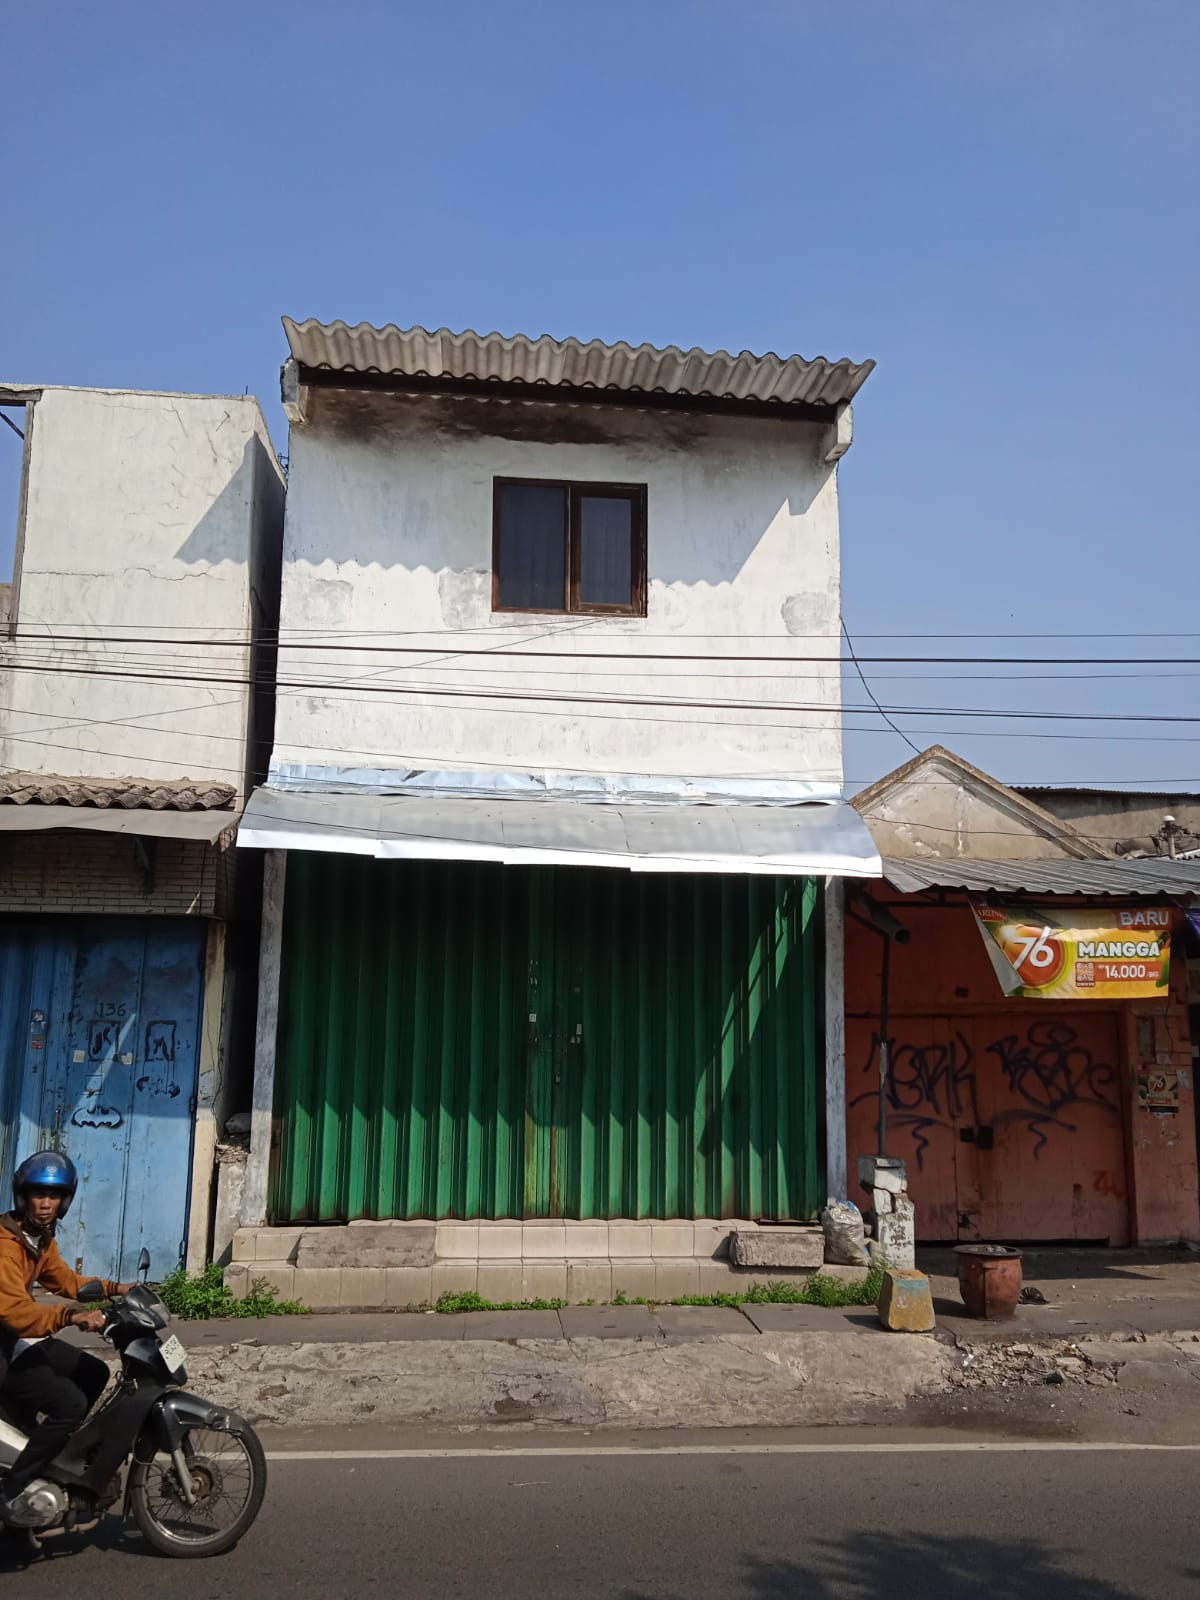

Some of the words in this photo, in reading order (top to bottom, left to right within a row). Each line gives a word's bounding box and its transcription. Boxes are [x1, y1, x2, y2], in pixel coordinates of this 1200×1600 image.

[1119, 911, 1169, 927] BARU
[1013, 926, 1055, 970] 76
[1078, 942, 1160, 958] MANGGA
[1105, 964, 1146, 979] 14.000
[99, 1001, 126, 1018] 136
